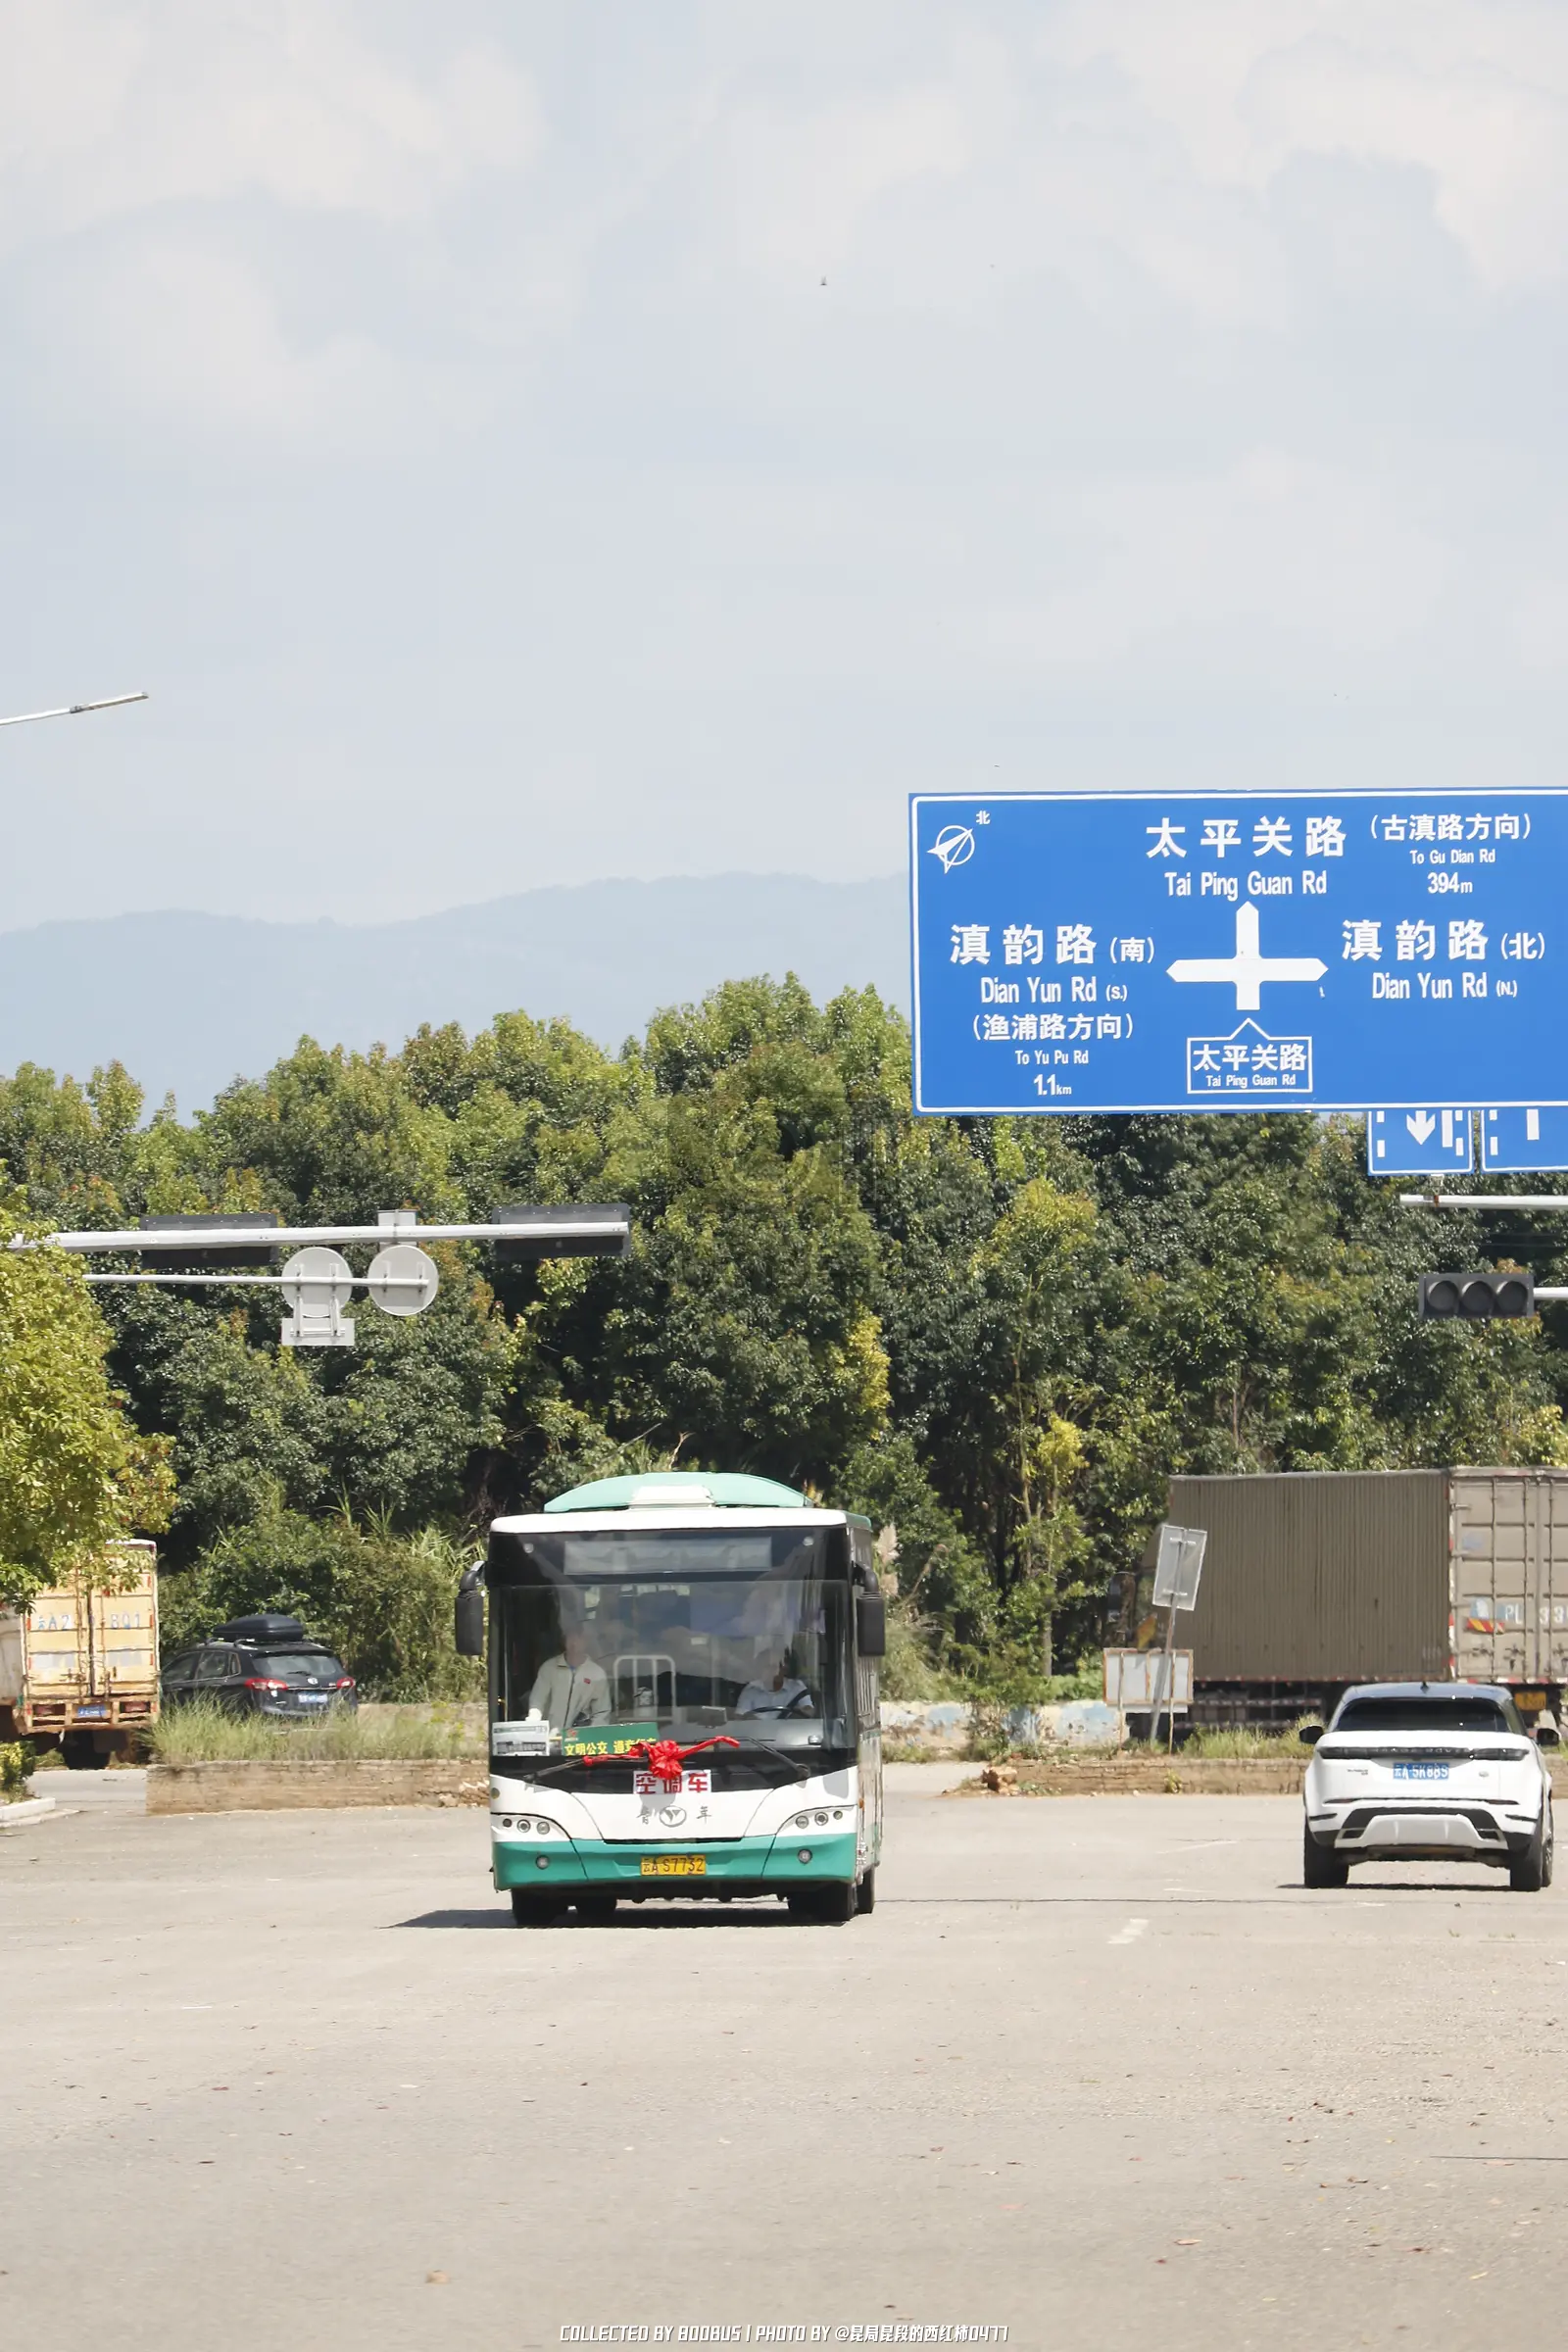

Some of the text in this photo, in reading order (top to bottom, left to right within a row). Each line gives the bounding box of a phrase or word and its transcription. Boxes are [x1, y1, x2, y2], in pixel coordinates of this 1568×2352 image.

[976, 810, 990, 824] 北
[1371, 813, 1530, 841] （古滇路方向）
[1147, 815, 1346, 858] 太平关路
[1410, 849, 1495, 864] To Gu Dian Rd
[1164, 870, 1326, 902] Tai Ping Guan Rd
[1428, 872, 1472, 893] 394m
[981, 977, 1019, 1003] Dian
[1027, 977, 1061, 1003] Yun
[1071, 976, 1097, 1002] Rd
[1372, 972, 1409, 999] Dian
[1417, 973, 1452, 999] Yun
[1462, 972, 1487, 998] Rd
[974, 1013, 1132, 1040] （渔浦路方向）
[1015, 1050, 1088, 1064] To Yu Pu Rd
[1194, 1044, 1306, 1071] 太平关路
[1206, 1074, 1296, 1089] Tai Ping Guan Rd
[564, 1742, 609, 1756] 文明公交
[635, 1773, 709, 1795] 空调车
